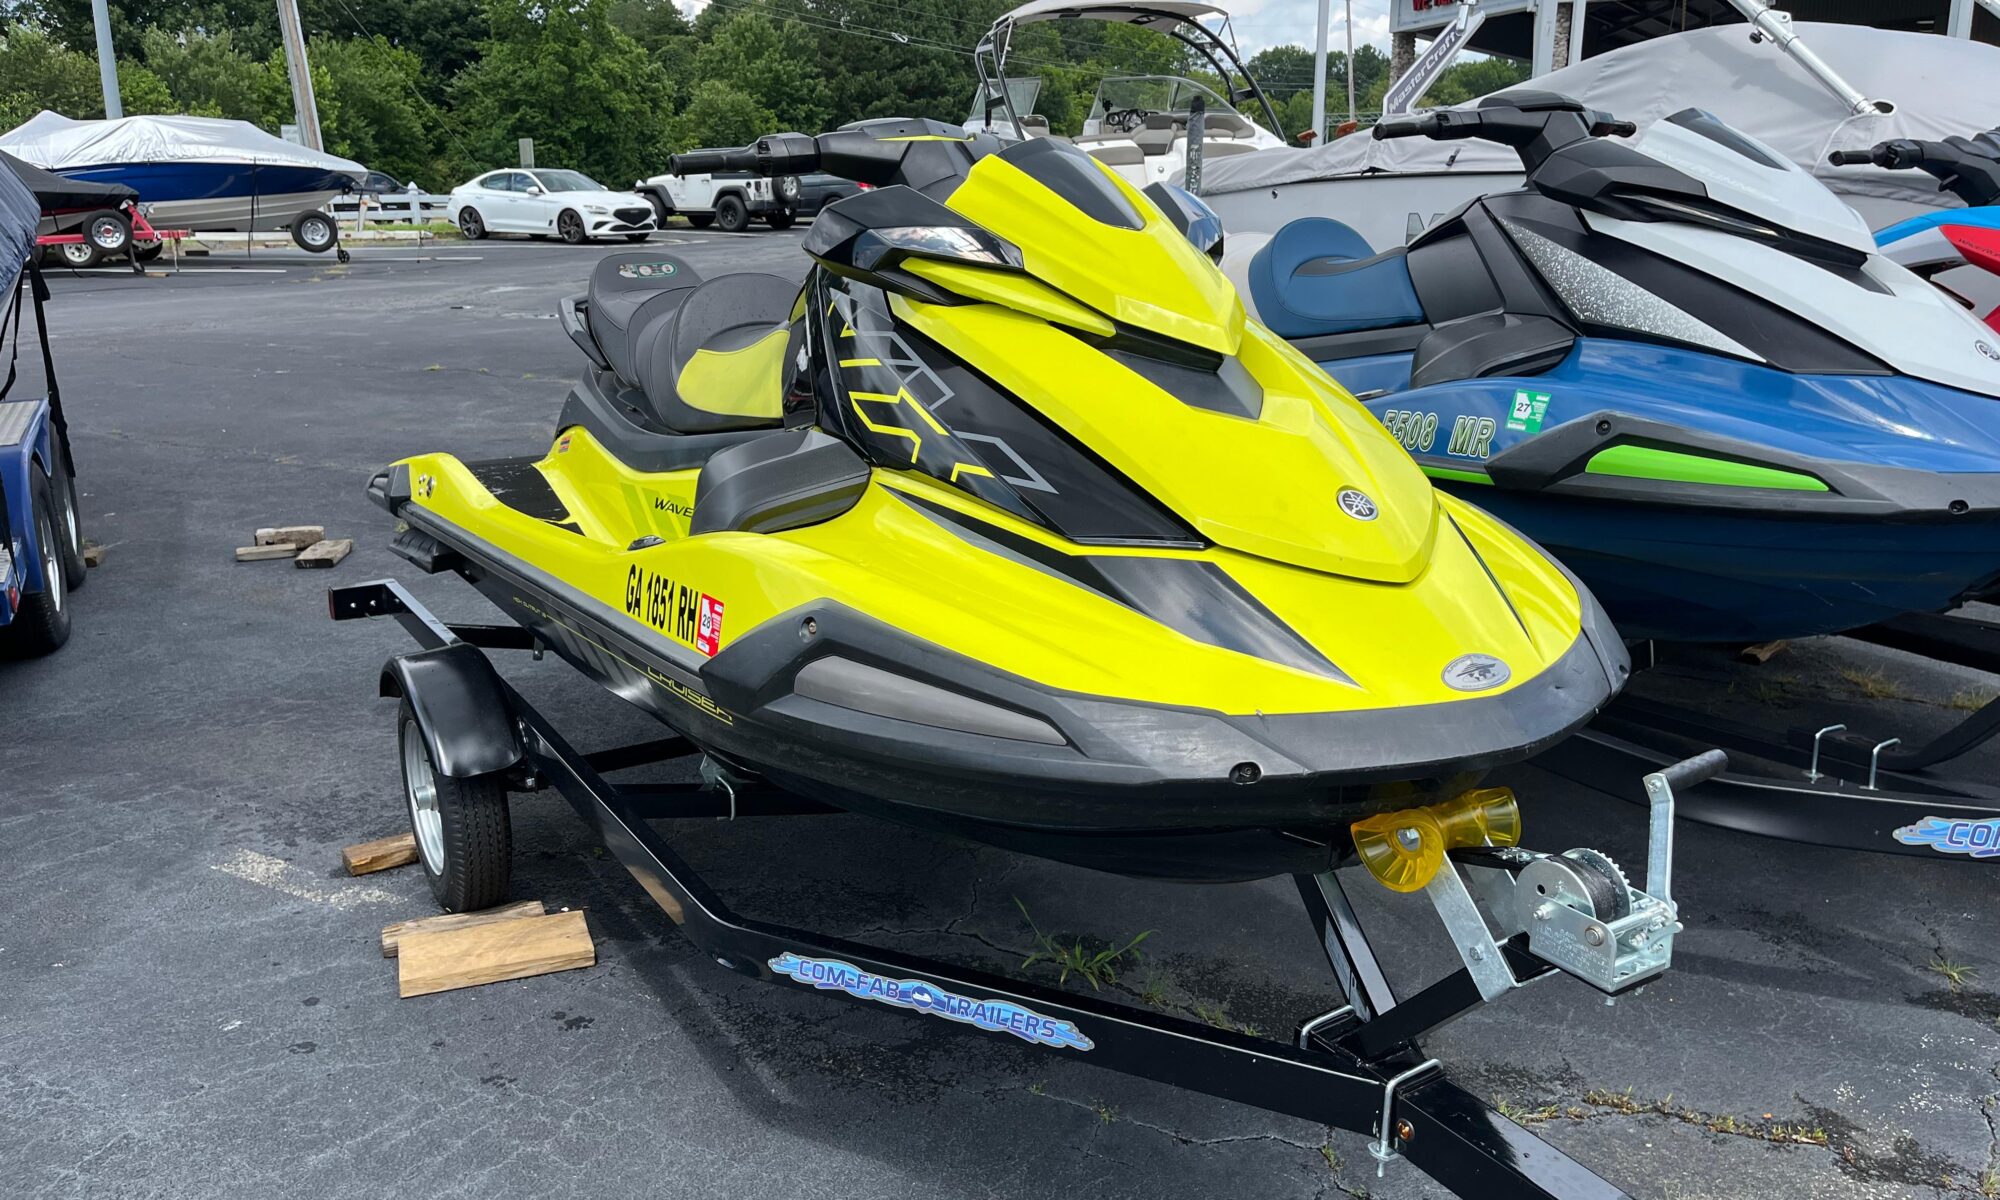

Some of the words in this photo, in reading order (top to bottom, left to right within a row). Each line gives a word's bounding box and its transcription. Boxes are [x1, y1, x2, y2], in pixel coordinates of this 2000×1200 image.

[1388, 31, 1456, 114] MasterCraft
[1516, 402, 1531, 412] 27
[1448, 415, 1497, 458] MR
[655, 496, 695, 518] WAVE
[626, 563, 643, 618] GA
[646, 571, 675, 633] 1851
[676, 584, 699, 645] RH
[702, 613, 711, 630] 28
[799, 959, 901, 1001] COM-FAB
[942, 993, 1057, 1039] TRAILERS
